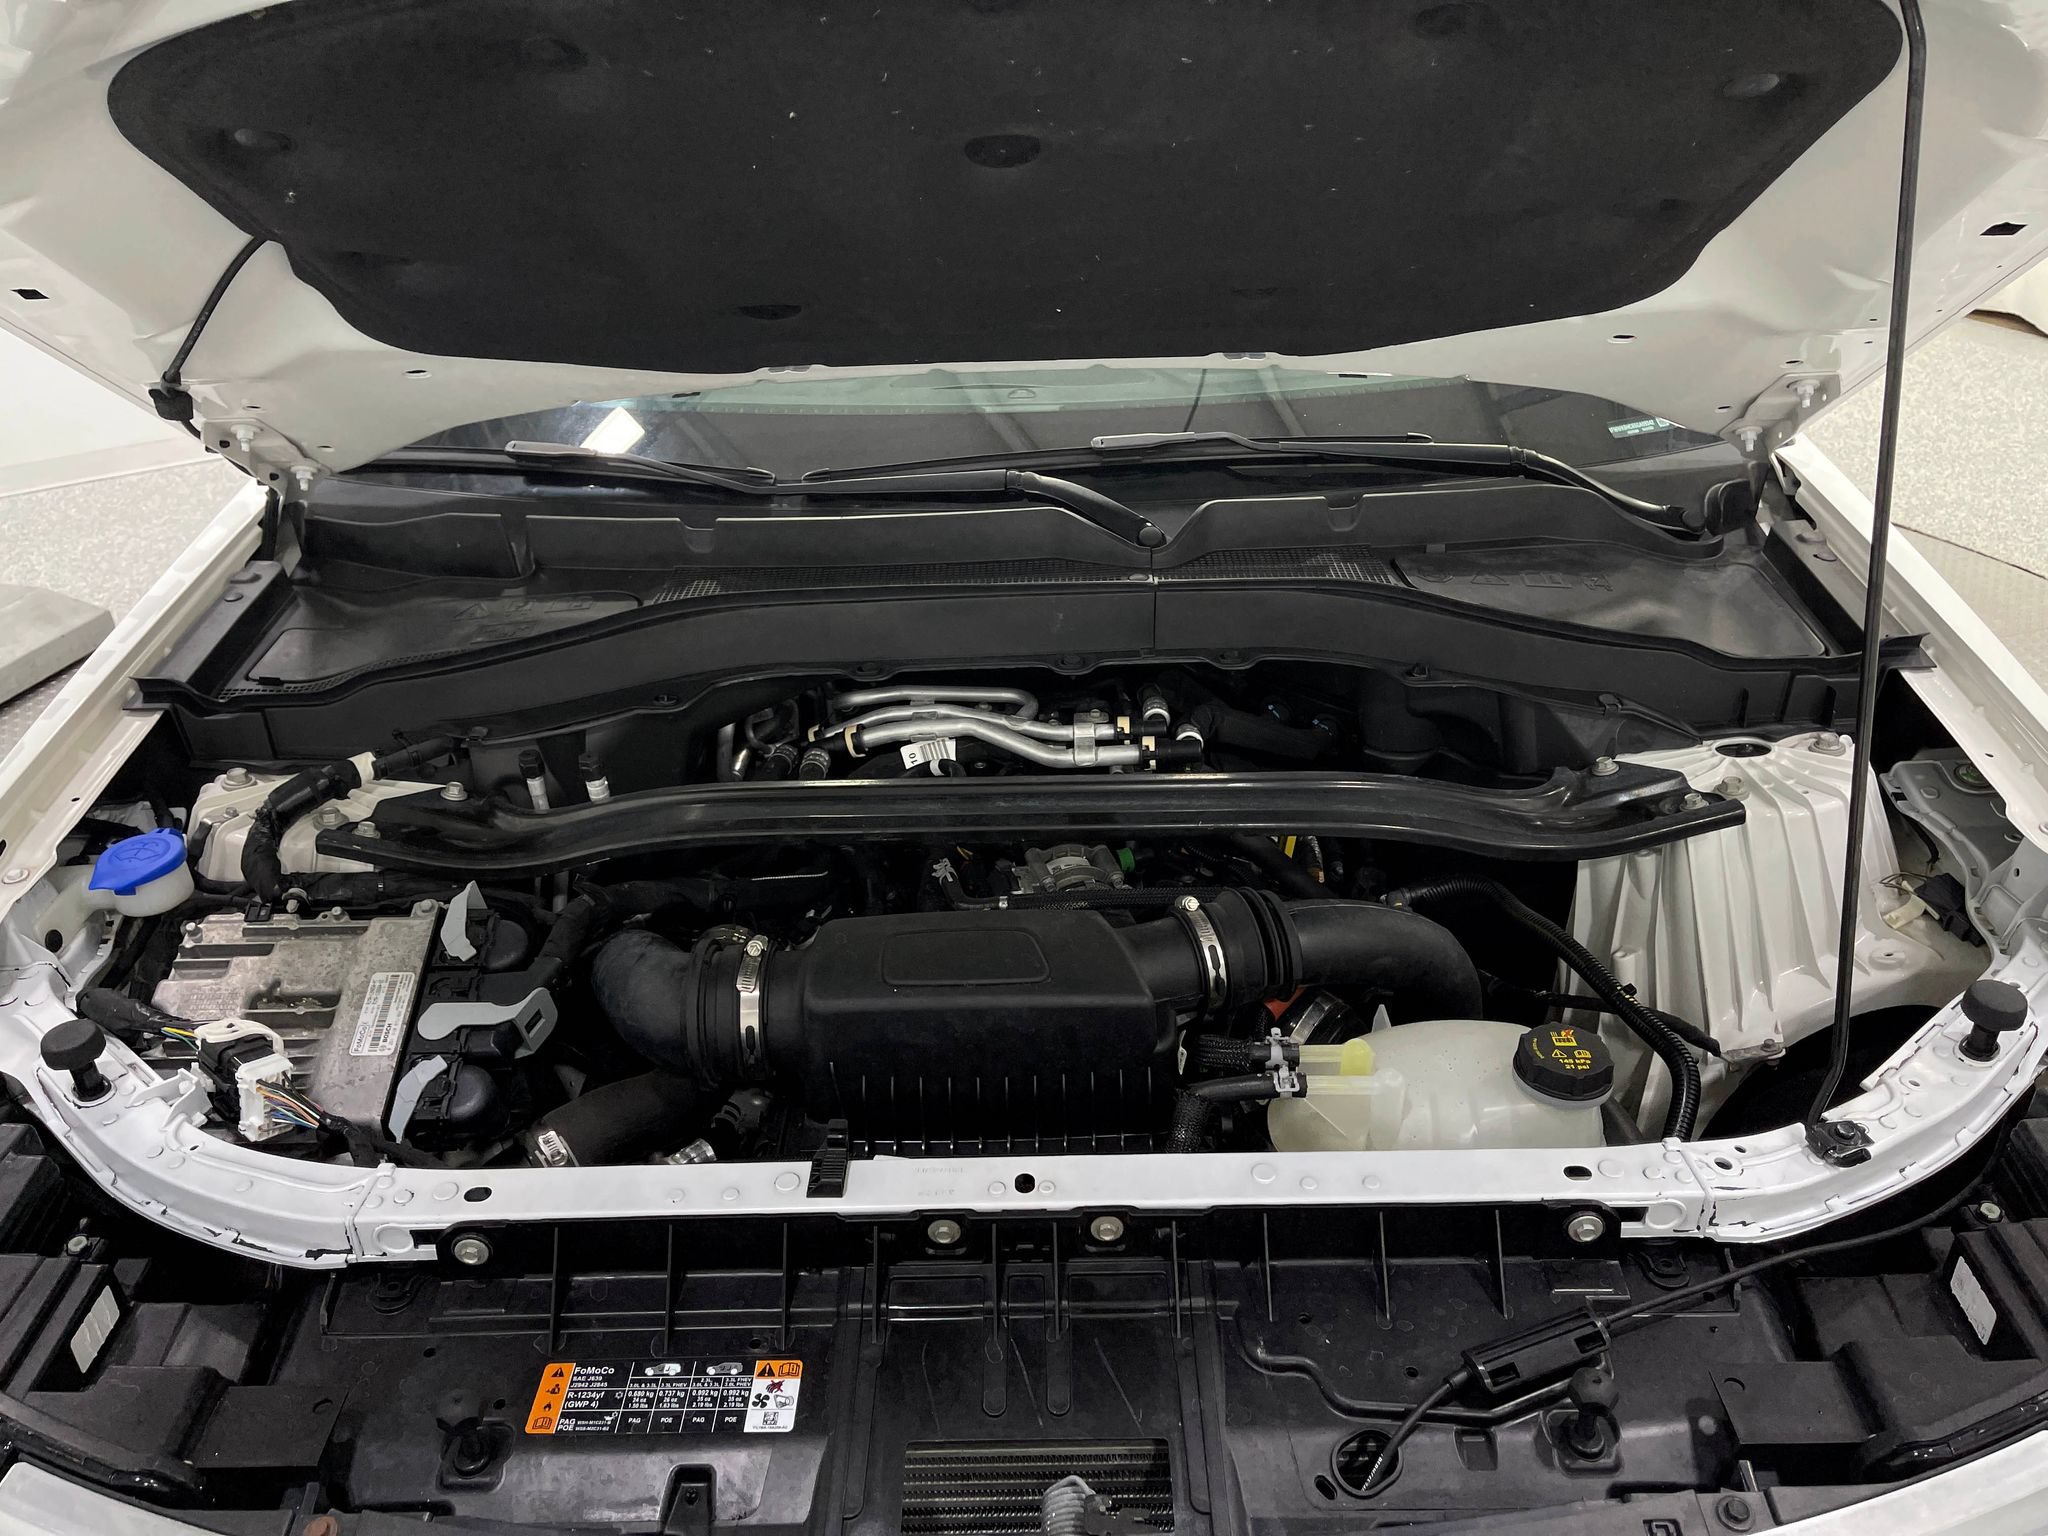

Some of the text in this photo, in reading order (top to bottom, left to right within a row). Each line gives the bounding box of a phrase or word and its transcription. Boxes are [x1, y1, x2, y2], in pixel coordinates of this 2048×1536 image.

[383, 1024, 392, 1043] BOSCH
[354, 1026, 369, 1052] FoMoCo
[574, 1366, 615, 1374] FoMoCo
[567, 1391, 605, 1400] R-1234yf
[646, 1390, 654, 1398] kg
[677, 1390, 685, 1398] kg
[564, 1401, 599, 1409] (GWP 4)
